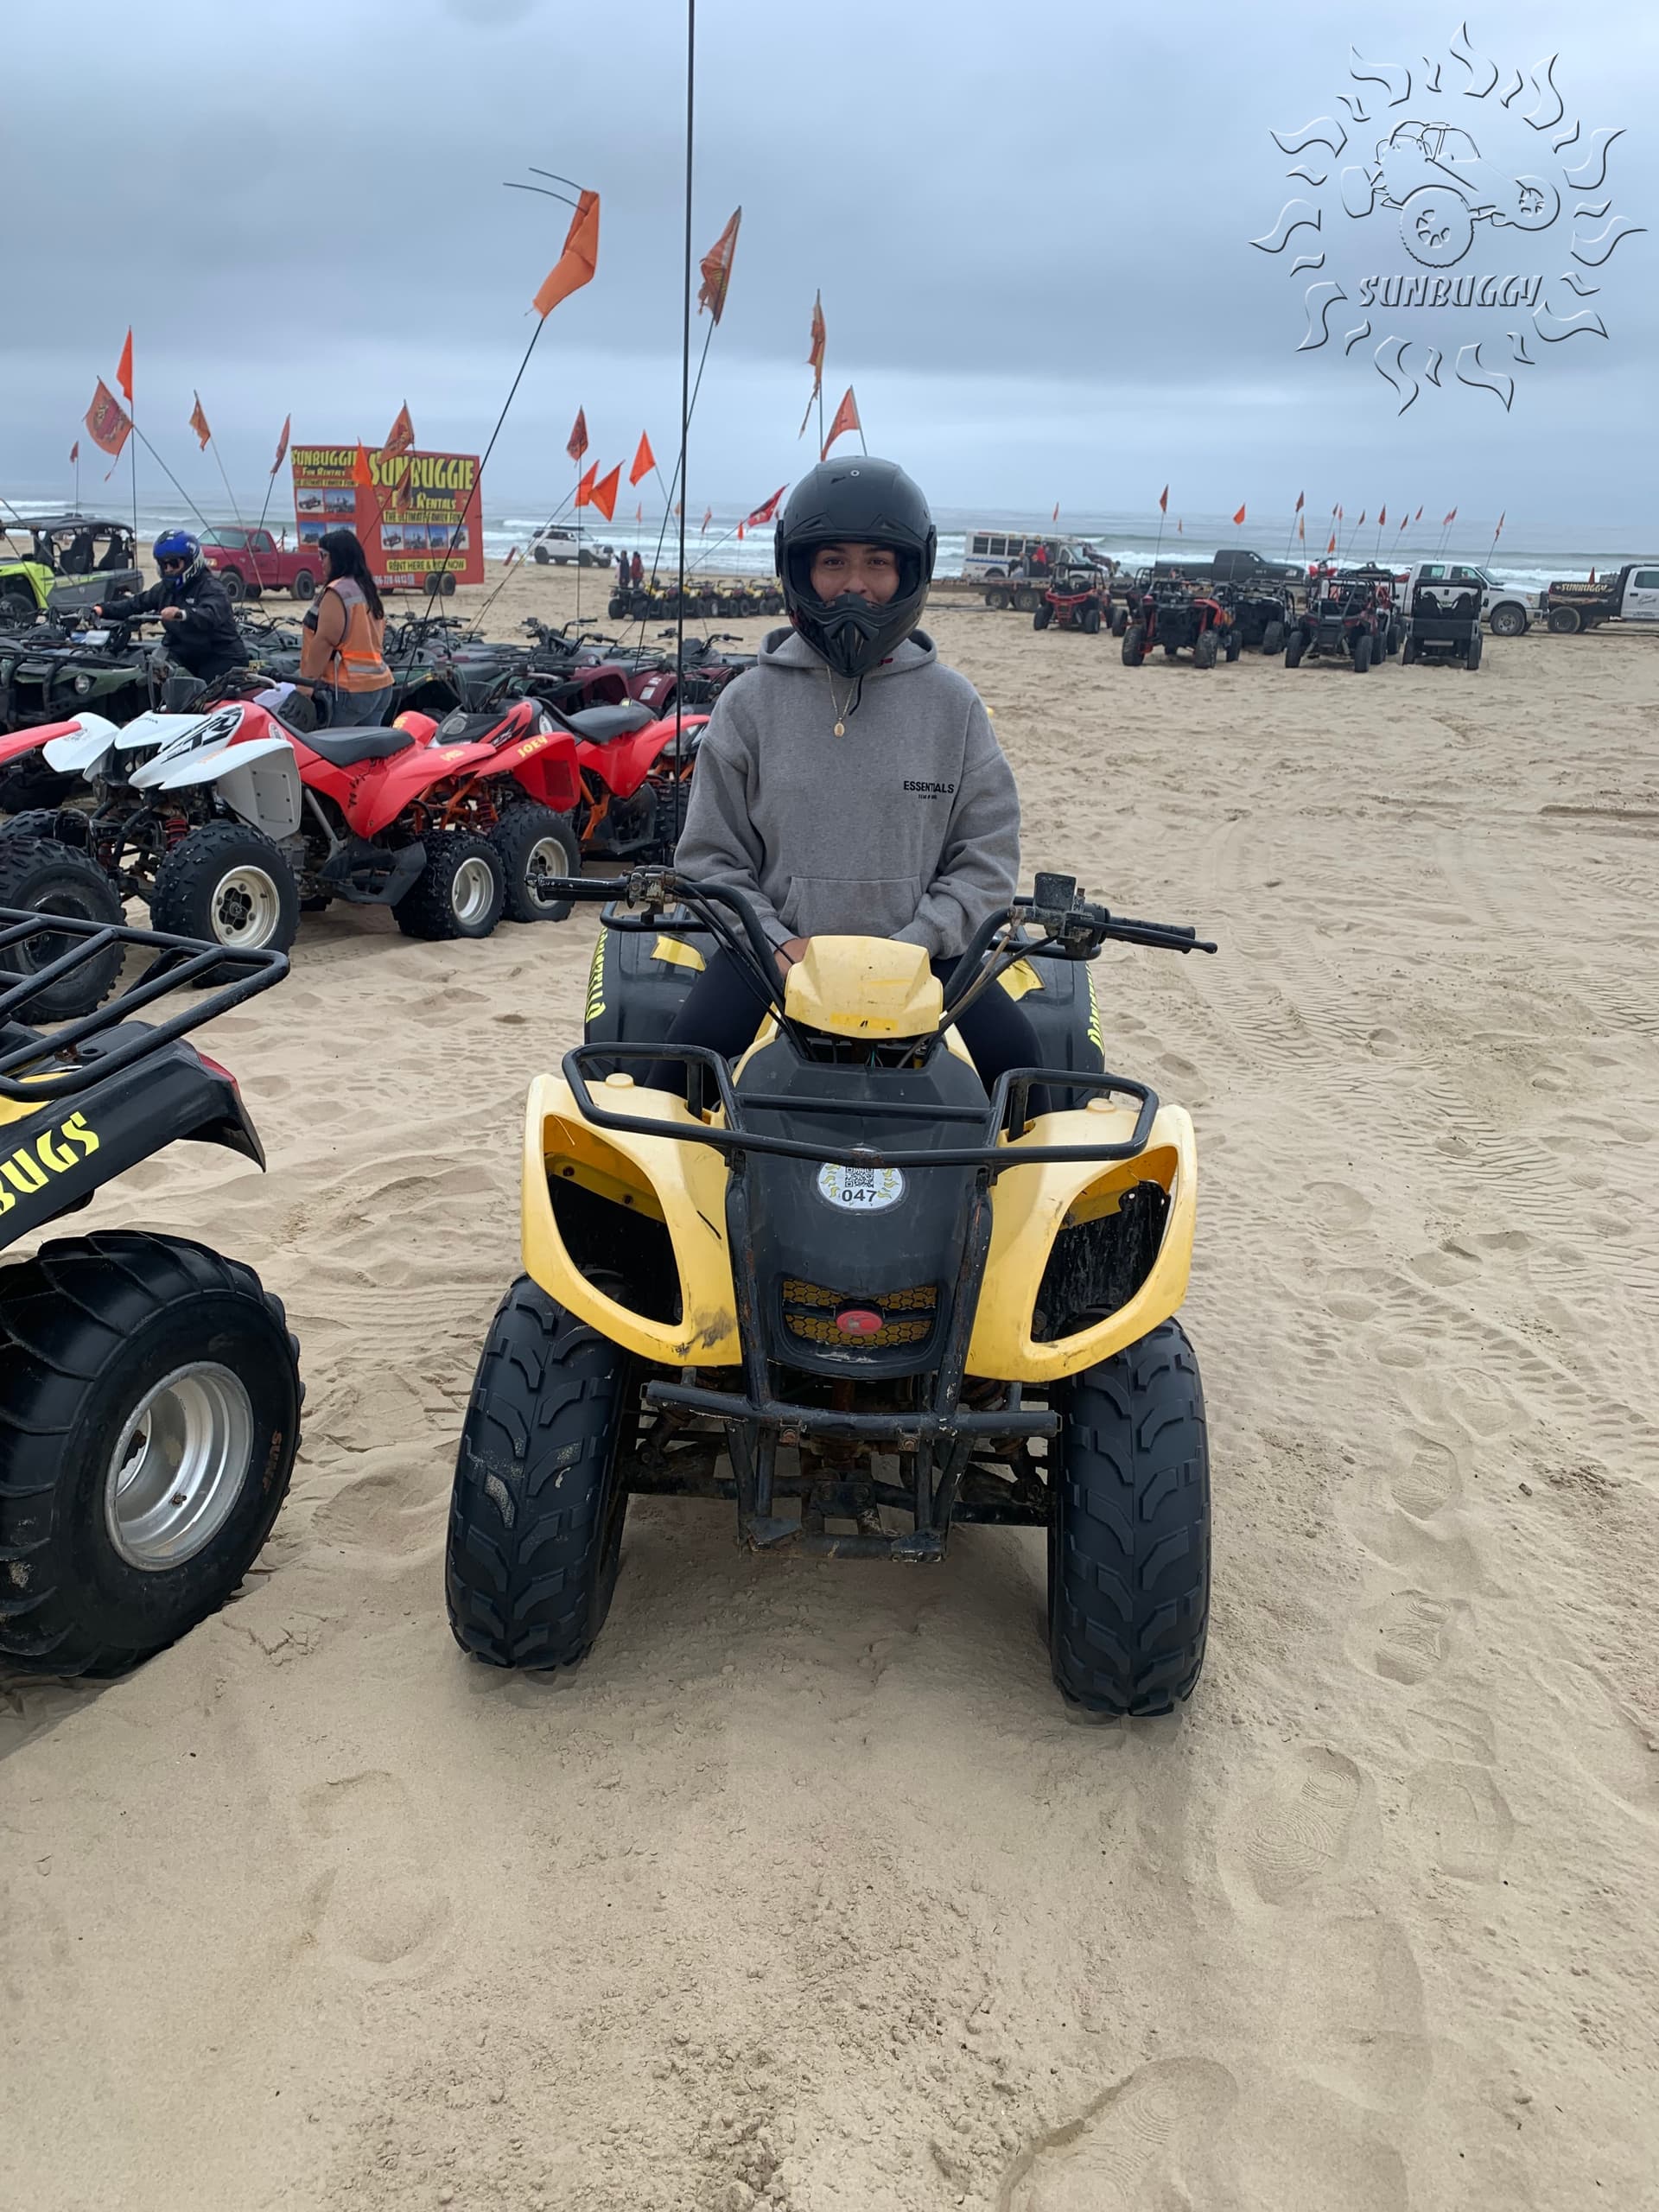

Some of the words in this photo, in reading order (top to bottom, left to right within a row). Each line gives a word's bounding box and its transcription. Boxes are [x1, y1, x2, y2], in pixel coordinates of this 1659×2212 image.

[368, 451, 474, 490] SUNBUGGIE
[518, 735, 548, 759] JOEY
[903, 780, 955, 794] ESSENTIALS
[842, 1189, 878, 1203] 047
